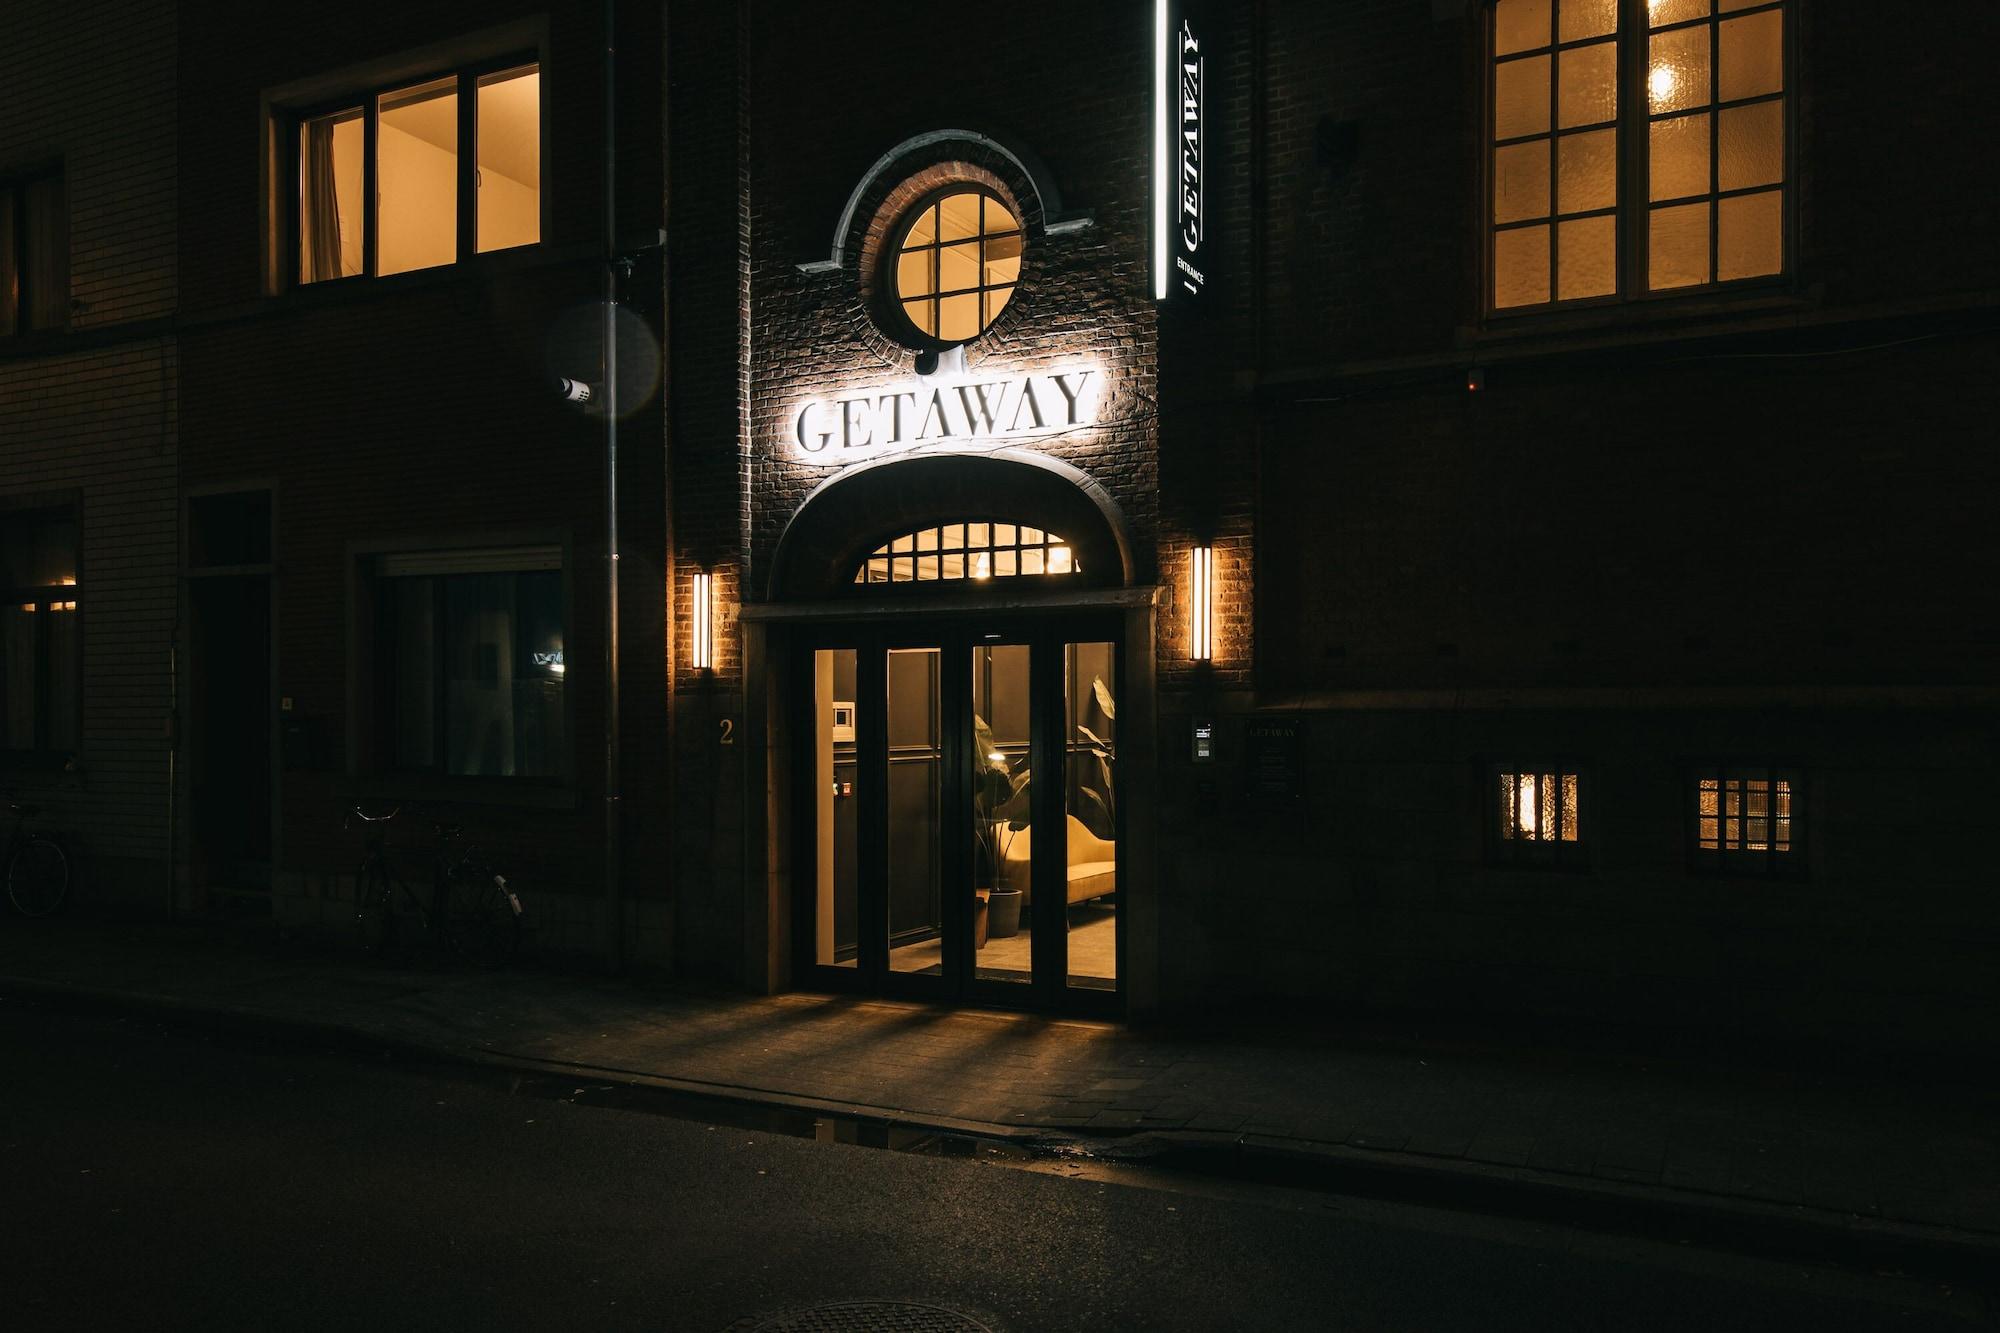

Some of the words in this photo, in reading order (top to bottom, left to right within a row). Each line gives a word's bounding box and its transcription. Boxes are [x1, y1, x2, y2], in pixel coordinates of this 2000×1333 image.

[1184, 19, 1199, 252] GETAWAY
[1177, 256, 1204, 285] ENTRANCE
[796, 370, 1096, 453] GETAWAY
[720, 719, 733, 744] 2
[1249, 728, 1297, 737] GETAWAY
